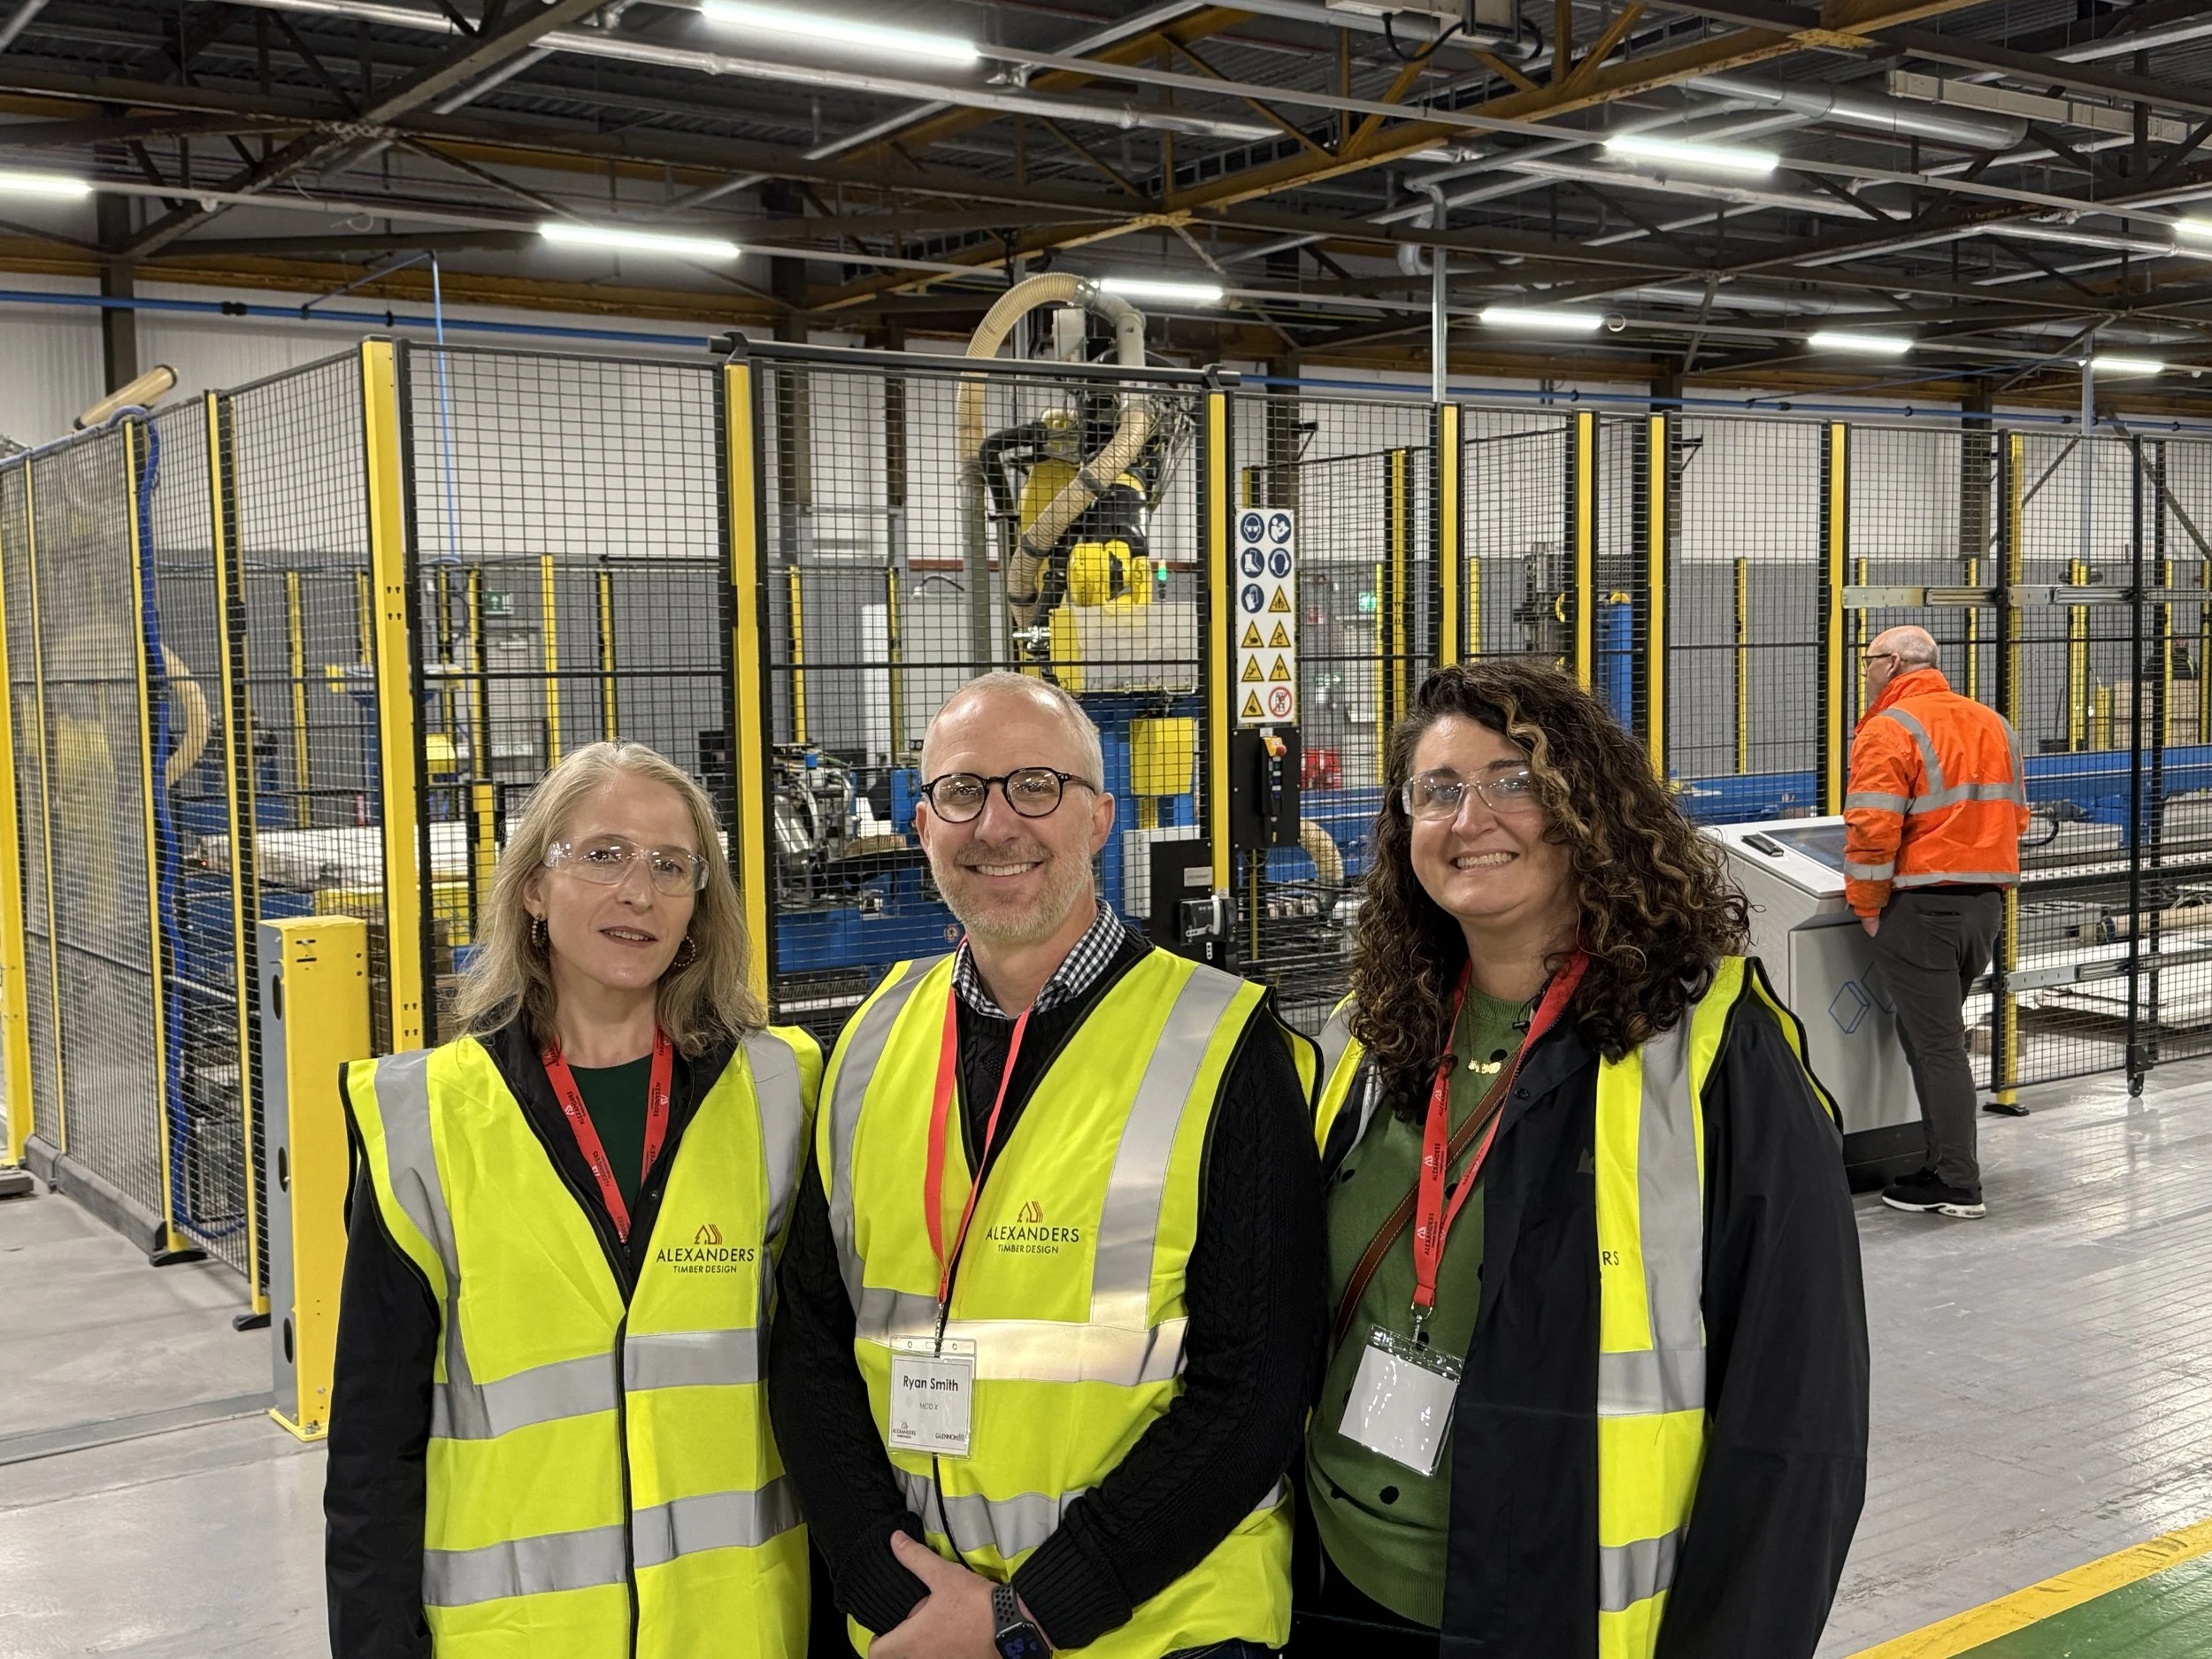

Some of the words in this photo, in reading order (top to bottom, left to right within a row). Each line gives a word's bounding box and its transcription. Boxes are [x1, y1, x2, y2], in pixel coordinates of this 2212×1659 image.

[986, 1225, 1079, 1242] ALEXANDERS
[656, 1248, 755, 1263] ALEXANDERS
[998, 1244, 1025, 1253] TIMBER
[1025, 1245, 1059, 1254] DESIGN
[902, 1375, 927, 1391] Ryan
[930, 1378, 958, 1392] Smith
